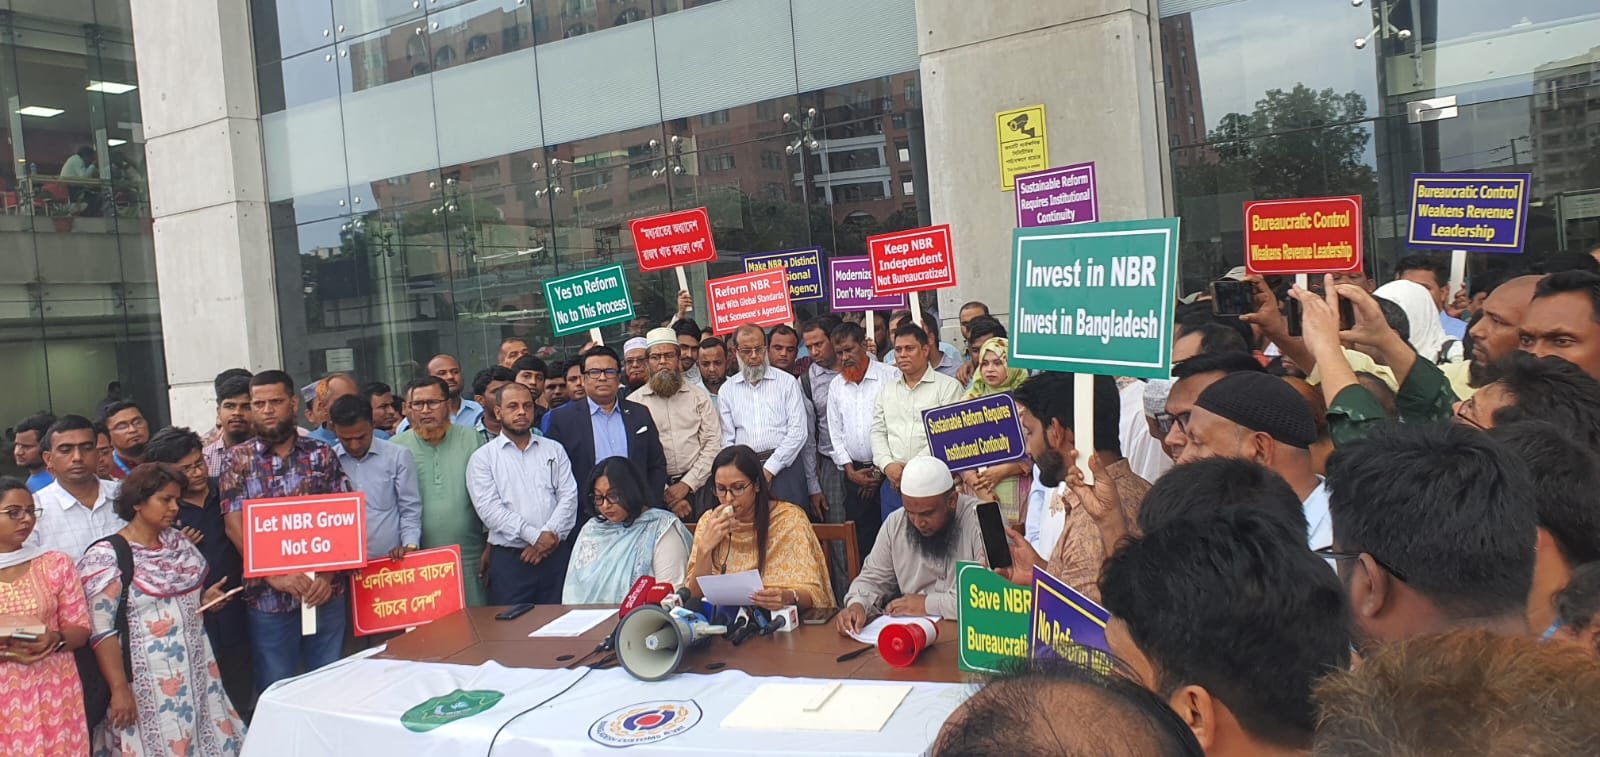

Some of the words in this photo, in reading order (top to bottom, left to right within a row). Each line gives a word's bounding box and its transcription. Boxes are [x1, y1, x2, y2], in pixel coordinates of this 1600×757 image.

[1021, 177, 1061, 194] Sustainable
[1061, 174, 1088, 187] Reform
[1418, 185, 1479, 198] Bureaucratic
[1480, 185, 1518, 199] Control
[1021, 196, 1049, 211] Requires
[1049, 188, 1091, 205] Institutional
[1037, 208, 1075, 224] Continuity
[1252, 212, 1312, 231] Bureaucratic
[1313, 210, 1350, 229] Control
[1418, 204, 1464, 218] Weakens
[1466, 205, 1514, 219] Revenue
[1431, 223, 1495, 241] Leadership
[884, 242, 909, 255] Keep
[911, 237, 933, 251] NBR
[1251, 244, 1281, 261] Weakens
[1282, 243, 1313, 260] Revenue
[1313, 241, 1352, 262] Leadership
[748, 262, 767, 271] Make
[768, 259, 782, 269] NBR
[790, 255, 817, 267] Distinct
[879, 252, 943, 271] Independent
[1026, 259, 1081, 287] Invest
[1086, 257, 1104, 287] in
[1111, 255, 1156, 287] NBR
[877, 275, 891, 286] Not
[892, 266, 948, 284] Bureaucratized
[554, 286, 572, 300] Yes
[572, 284, 583, 296] to
[583, 276, 618, 294] Reform
[715, 284, 748, 298] Reform
[750, 279, 770, 291] NBR
[790, 283, 818, 296] Agency
[836, 287, 853, 299] Don't
[716, 302, 726, 311] But
[726, 300, 739, 309] With
[740, 296, 757, 306] Global
[757, 291, 784, 304] Standards
[556, 311, 569, 325] No
[569, 309, 579, 322] to
[578, 304, 596, 319] This
[596, 299, 627, 315] Process
[717, 315, 729, 323] Not
[729, 310, 761, 321] Someone's
[762, 305, 787, 317] Agendas
[1020, 307, 1057, 335] Invest
[1061, 308, 1072, 335] in
[1076, 308, 1158, 344] Bangladesh
[928, 412, 963, 434] Sustainable
[961, 409, 985, 427] Reform
[982, 402, 1011, 424] Requires
[944, 439, 980, 461] Institutional
[978, 433, 1010, 453] Continuity
[255, 516, 278, 533] Let
[282, 513, 313, 531] NBR
[317, 511, 354, 528] Grow
[281, 539, 307, 556] Not
[311, 537, 331, 553] Go
[418, 562, 455, 582] বাচলে
[372, 597, 407, 618] বাঁচবে
[969, 584, 1000, 611] Save
[1004, 587, 1032, 614] NBR
[967, 626, 1029, 657] Bureaucrati
[1037, 610, 1050, 646] No
[1053, 620, 1088, 665] Reform
